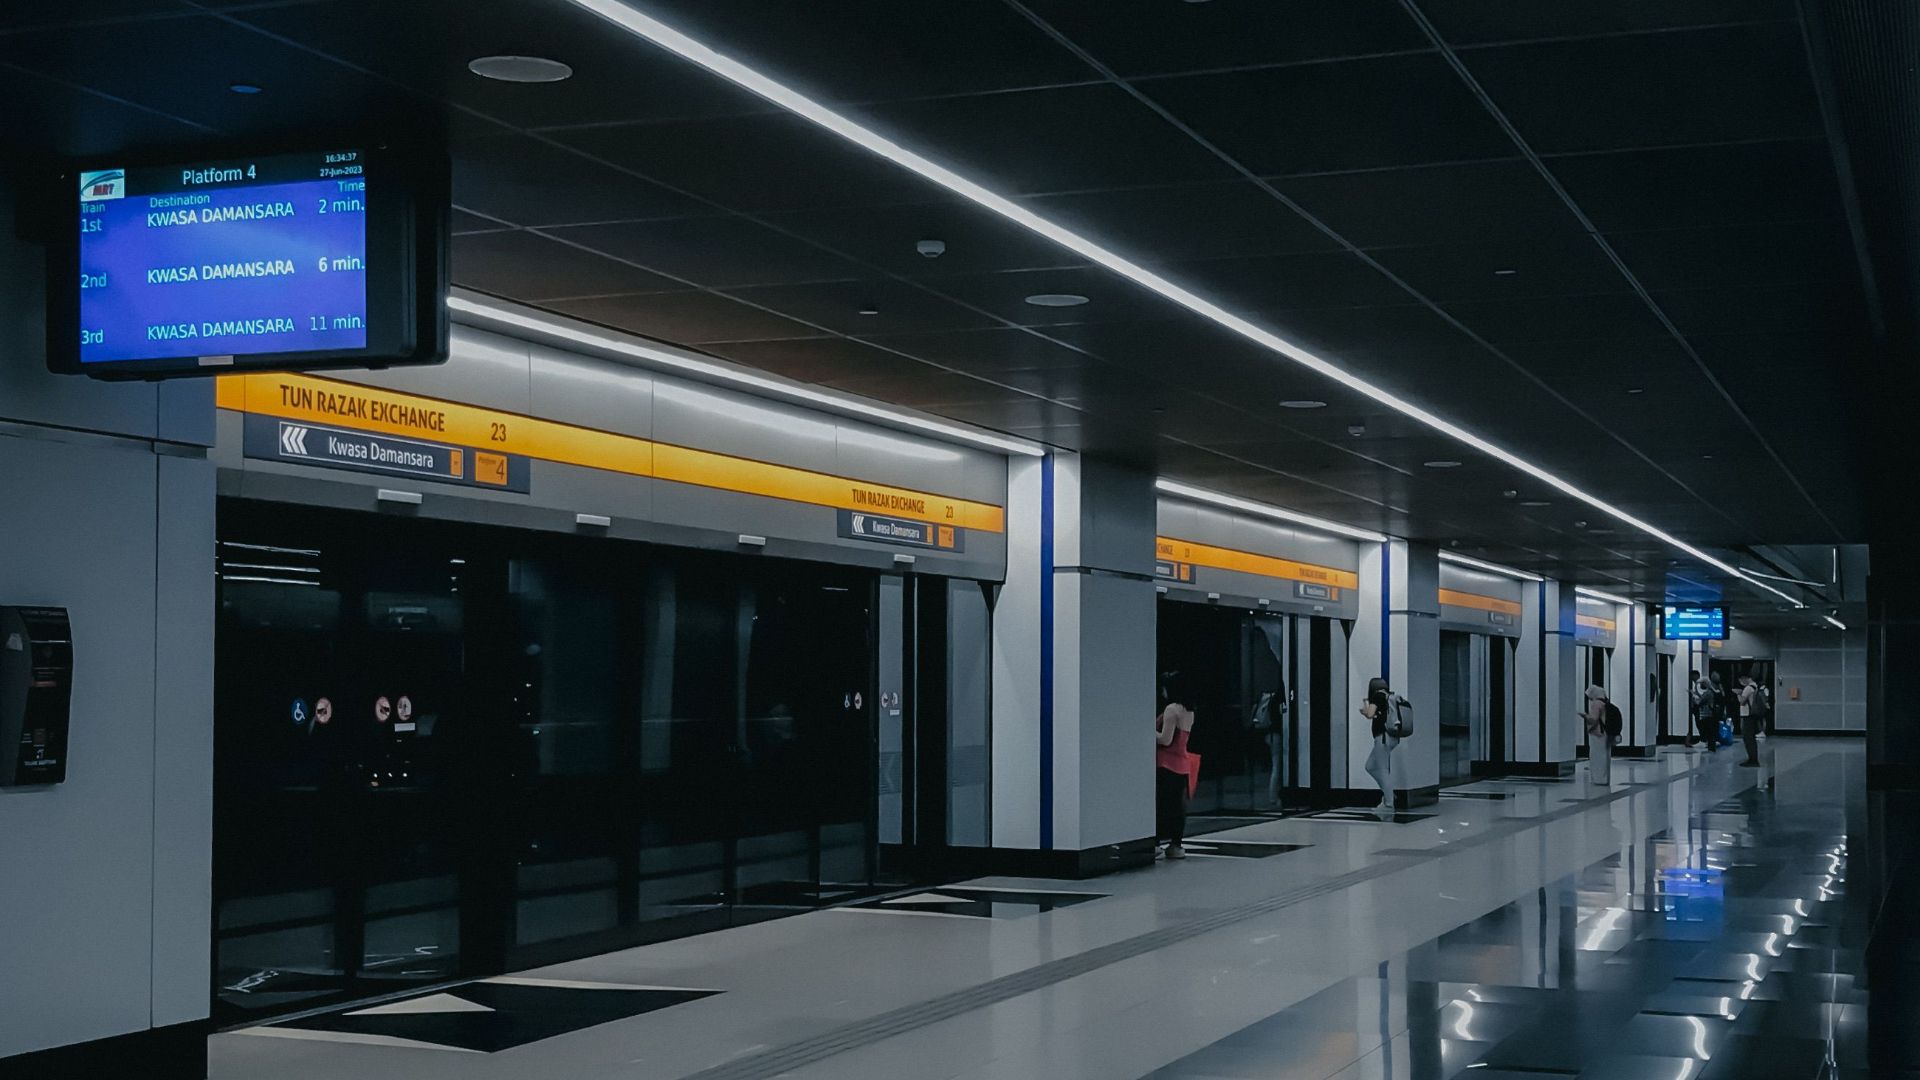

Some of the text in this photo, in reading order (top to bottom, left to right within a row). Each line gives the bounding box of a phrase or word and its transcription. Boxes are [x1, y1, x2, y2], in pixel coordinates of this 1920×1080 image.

[325, 152, 357, 163] 16:34:37
[183, 164, 256, 185] Platform 4
[320, 165, 363, 177] 27-Jun-2023
[337, 180, 365, 192] Time
[81, 203, 106, 213] Train
[150, 194, 210, 208] Destination
[319, 197, 365, 214] 2 min.
[147, 202, 295, 227] KWASA DAMANSARA
[81, 218, 103, 232] 1st
[147, 259, 295, 284] KWASA DAMANSARA
[318, 255, 365, 272] 6 min.
[81, 273, 107, 289] 2nd
[147, 318, 295, 341] KWASA DAMANSARA
[310, 315, 365, 331] 11 min.
[81, 329, 104, 344] 3rd
[279, 384, 445, 432] TUN RAZAK EXCHANGE
[490, 422, 507, 442] 23
[328, 436, 434, 469] Kwasa Damansara
[496, 459, 505, 480] 4
[852, 489, 925, 514] TUN RAZAK EXCHANGE
[945, 505, 954, 519] 23
[872, 520, 920, 539] Kwasa Damansara
